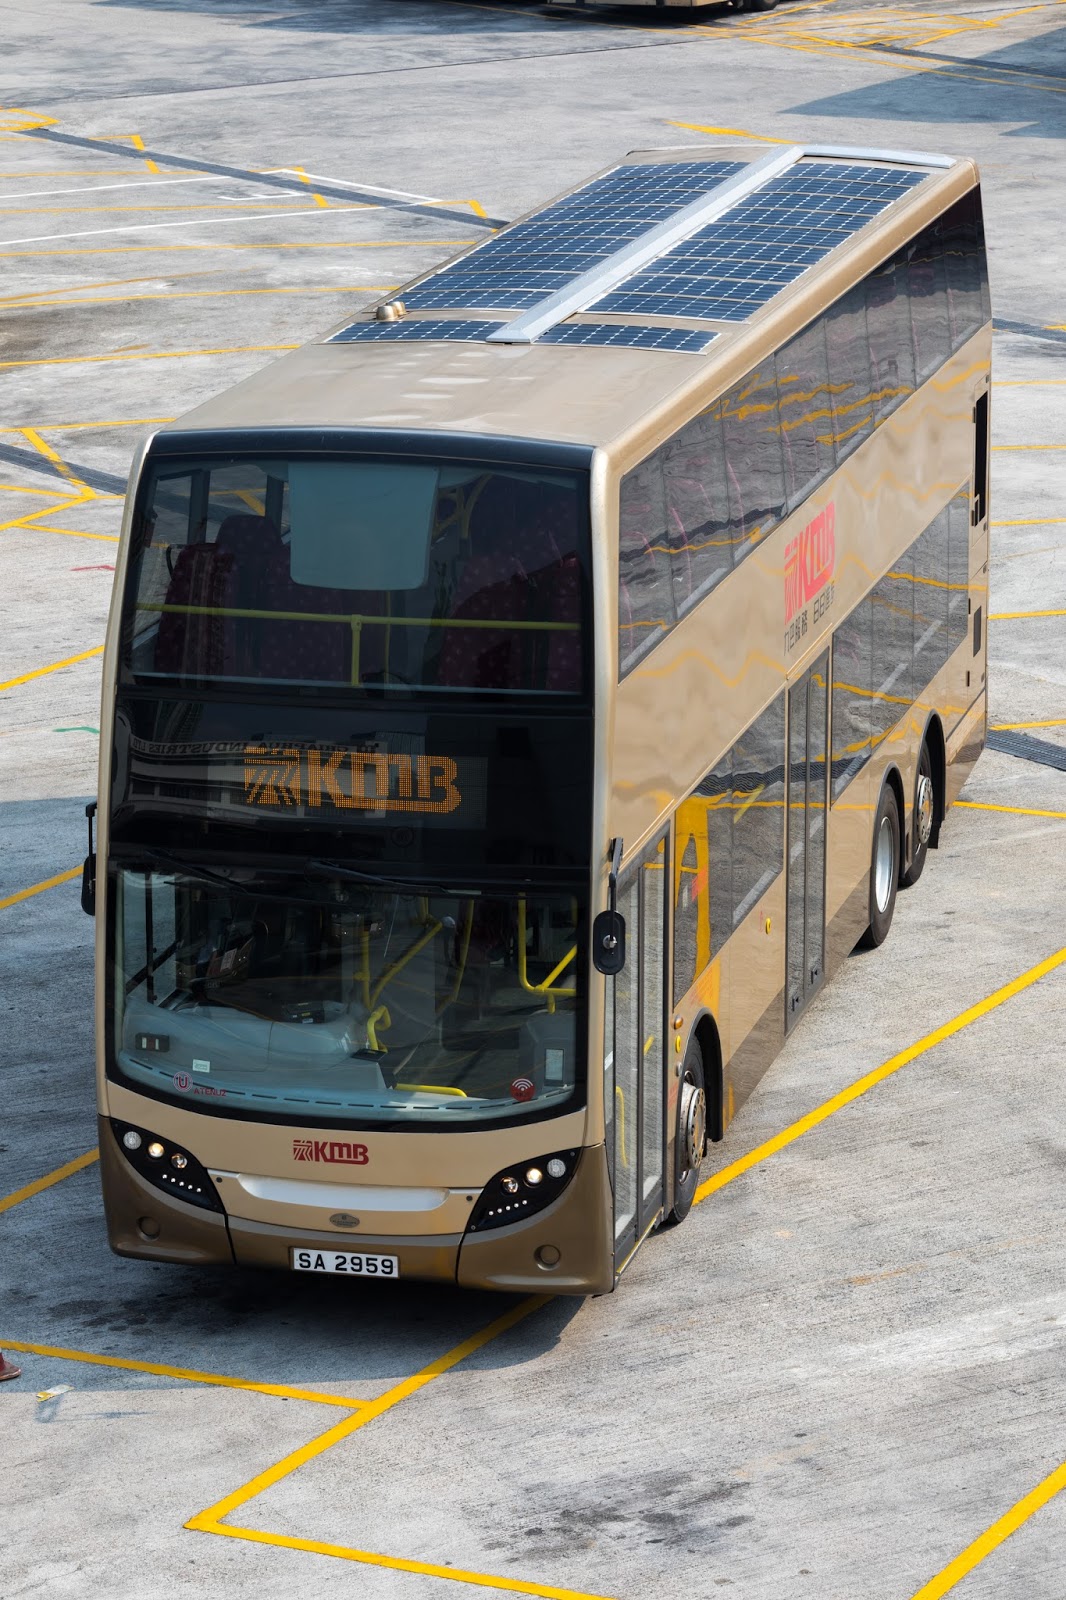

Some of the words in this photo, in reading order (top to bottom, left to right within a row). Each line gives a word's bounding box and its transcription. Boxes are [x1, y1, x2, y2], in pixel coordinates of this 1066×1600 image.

[798, 500, 835, 609] KMB
[307, 750, 462, 814] KMB
[314, 1141, 369, 1165] KMB
[298, 1252, 326, 1271] SA
[334, 1255, 394, 1275] 2959
